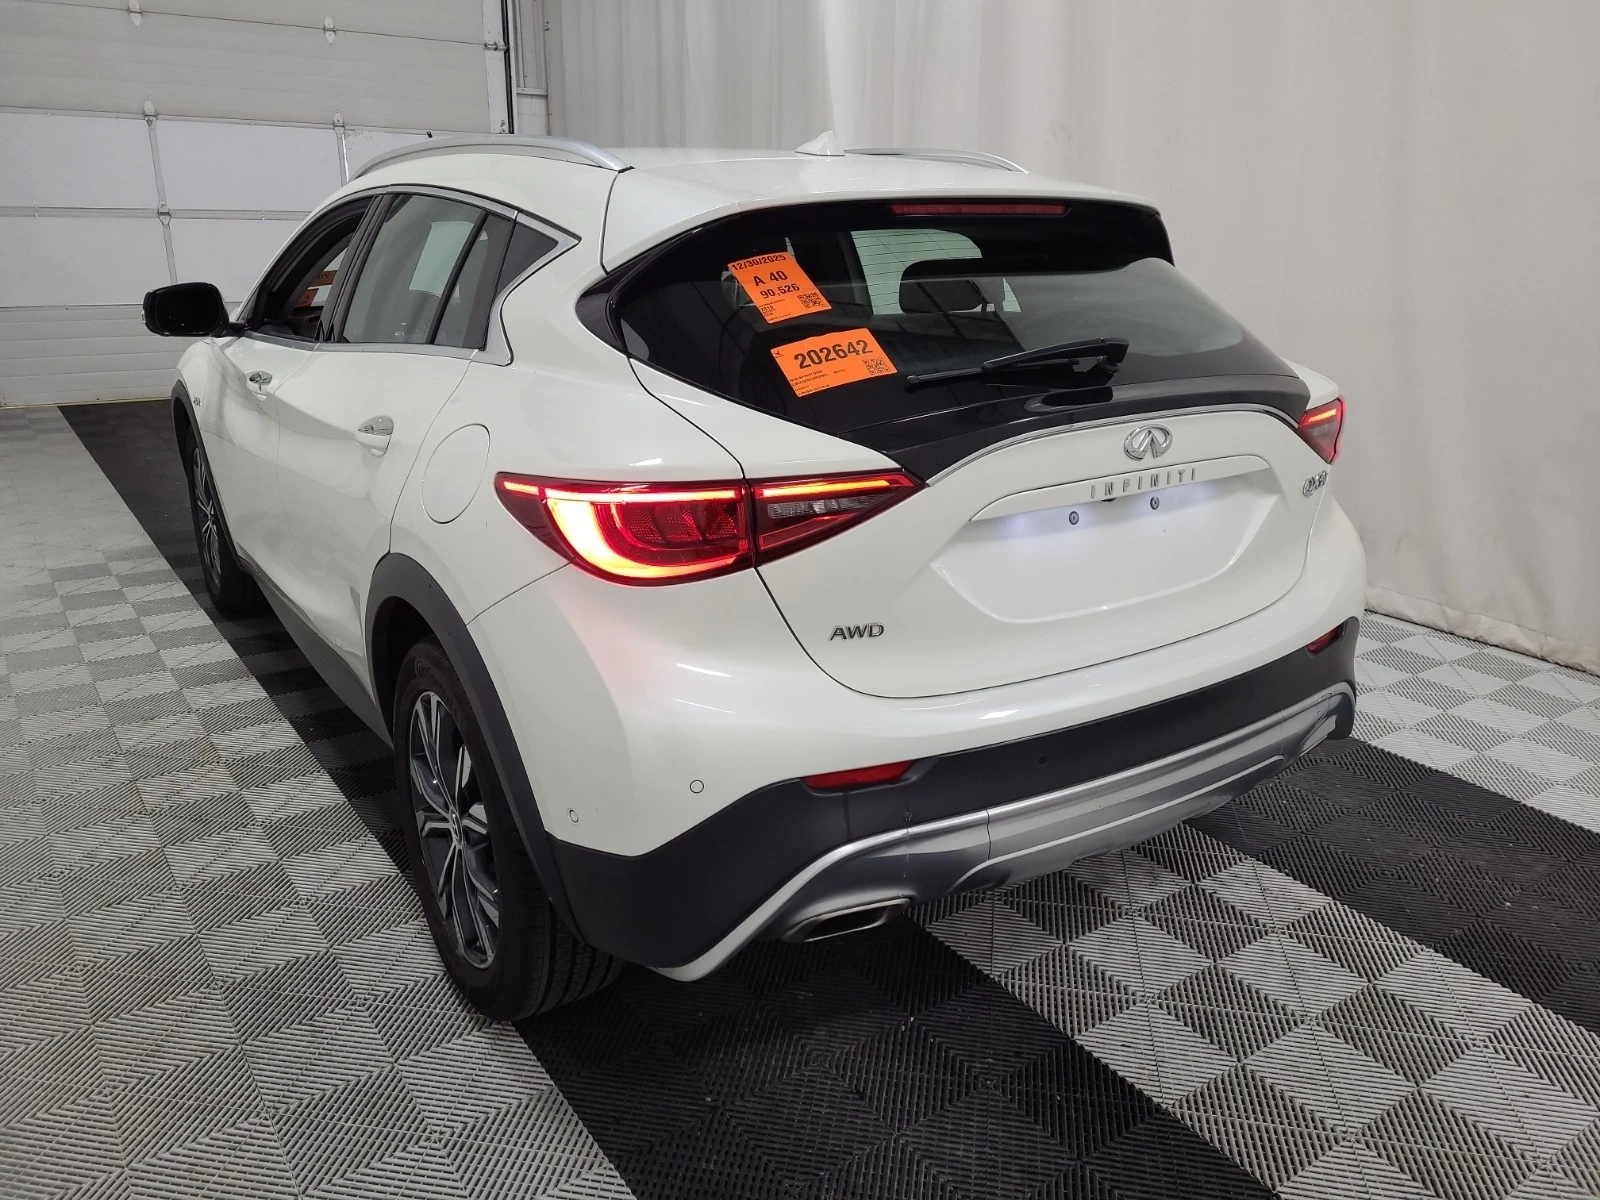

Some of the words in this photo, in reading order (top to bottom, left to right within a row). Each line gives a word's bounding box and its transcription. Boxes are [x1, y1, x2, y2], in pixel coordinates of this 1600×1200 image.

[731, 254, 787, 271] 12/30/2025
[753, 275, 766, 287] A
[769, 270, 788, 282] 40
[760, 283, 800, 299] 90,526
[793, 339, 873, 369] 202642
[1090, 467, 1196, 499] INFINITI
[829, 622, 885, 641] AWD
